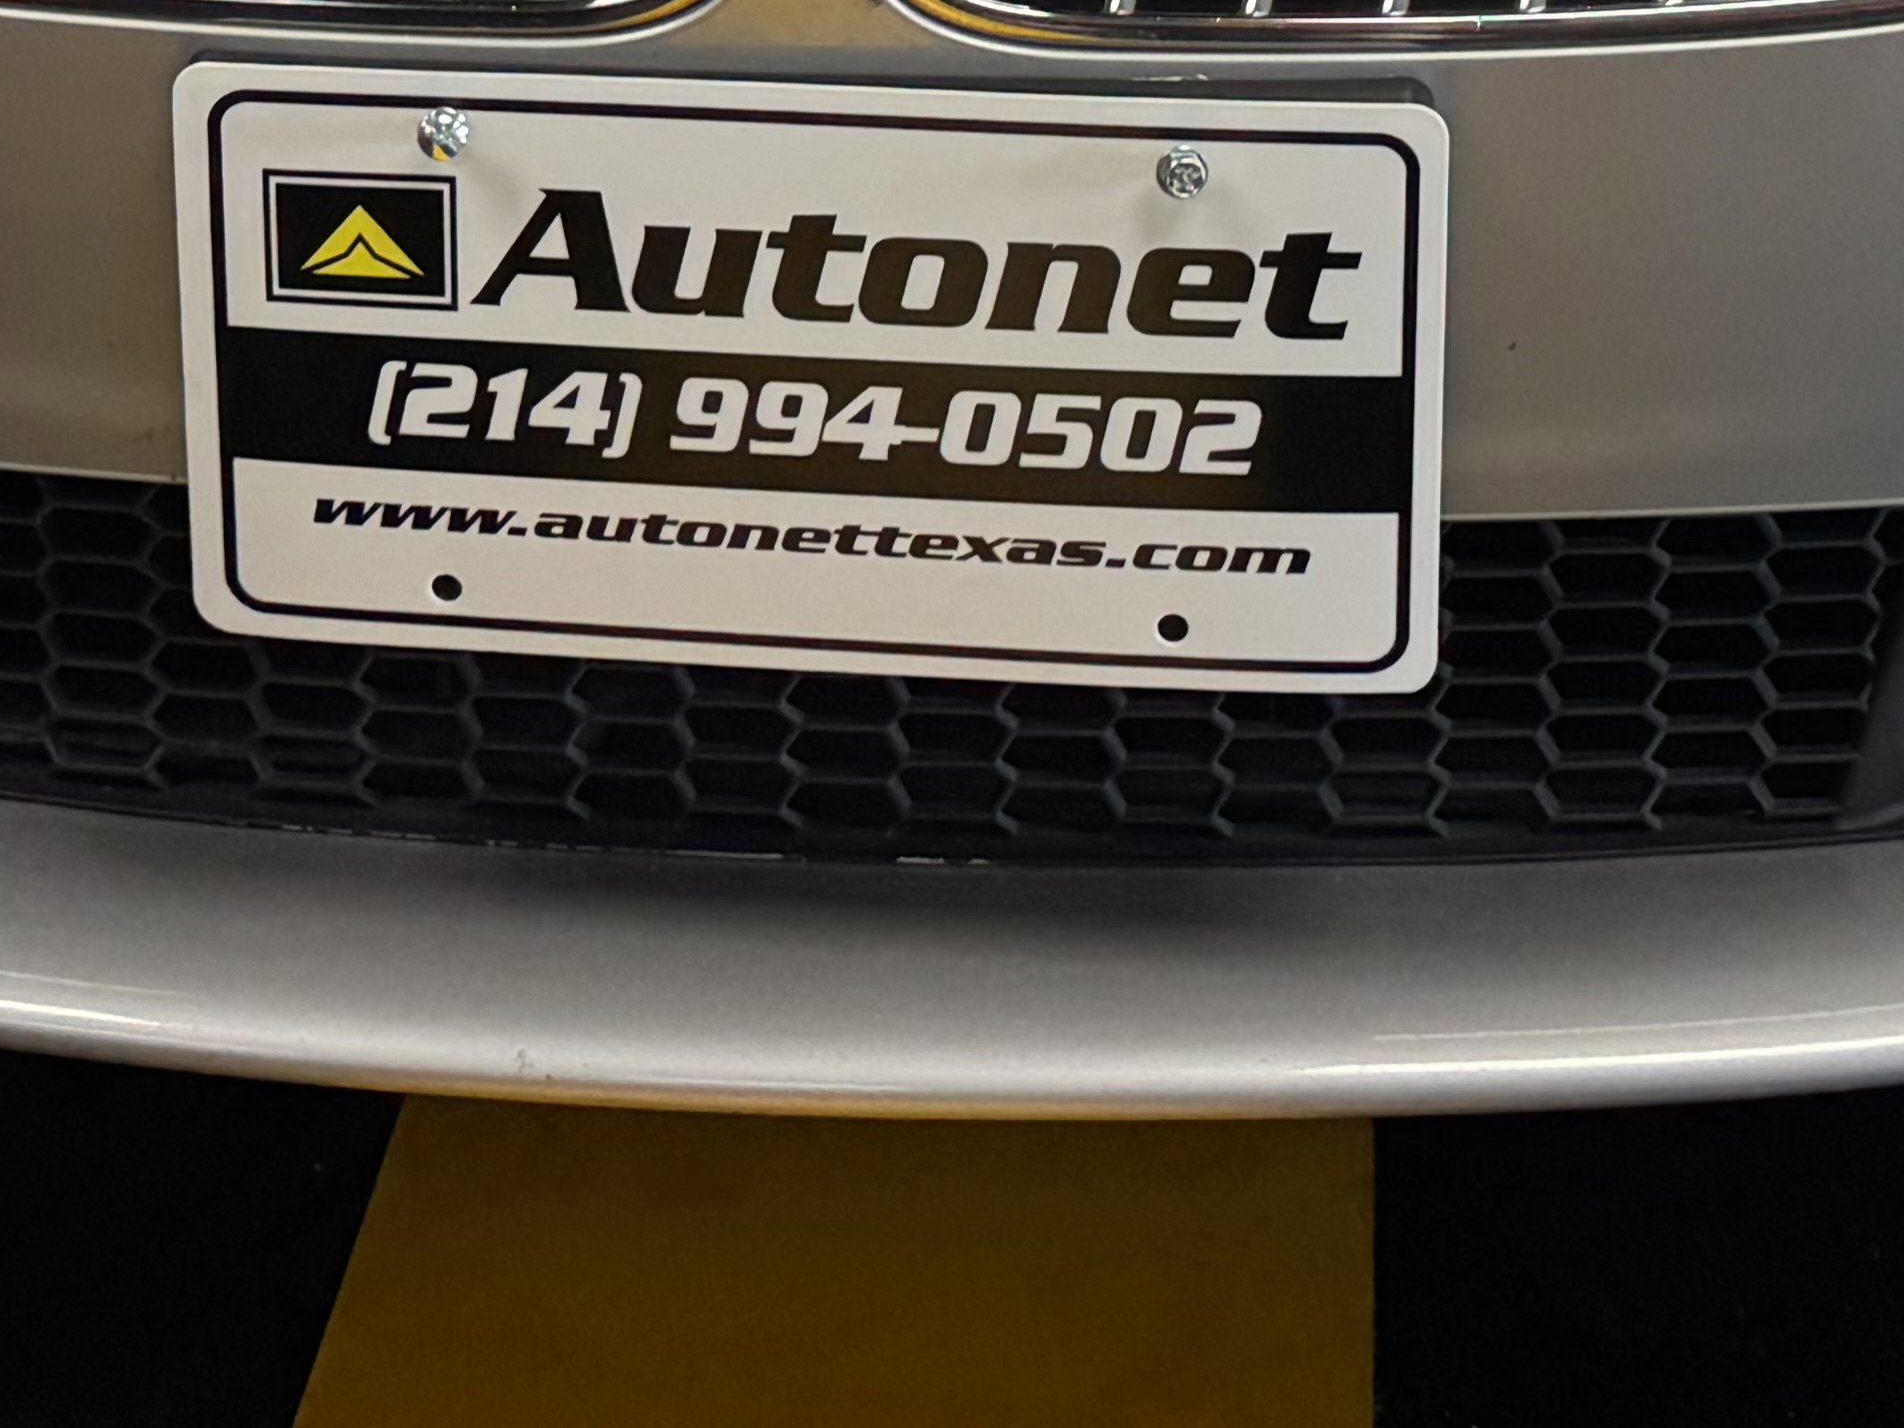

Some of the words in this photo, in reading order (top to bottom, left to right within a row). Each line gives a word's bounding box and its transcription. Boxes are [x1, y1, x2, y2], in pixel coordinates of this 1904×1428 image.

[471, 187, 1362, 340] Autonet
[368, 360, 641, 458] (214)
[670, 377, 1262, 476] 994-0502
[312, 497, 1312, 576] www.autonettexas.com
